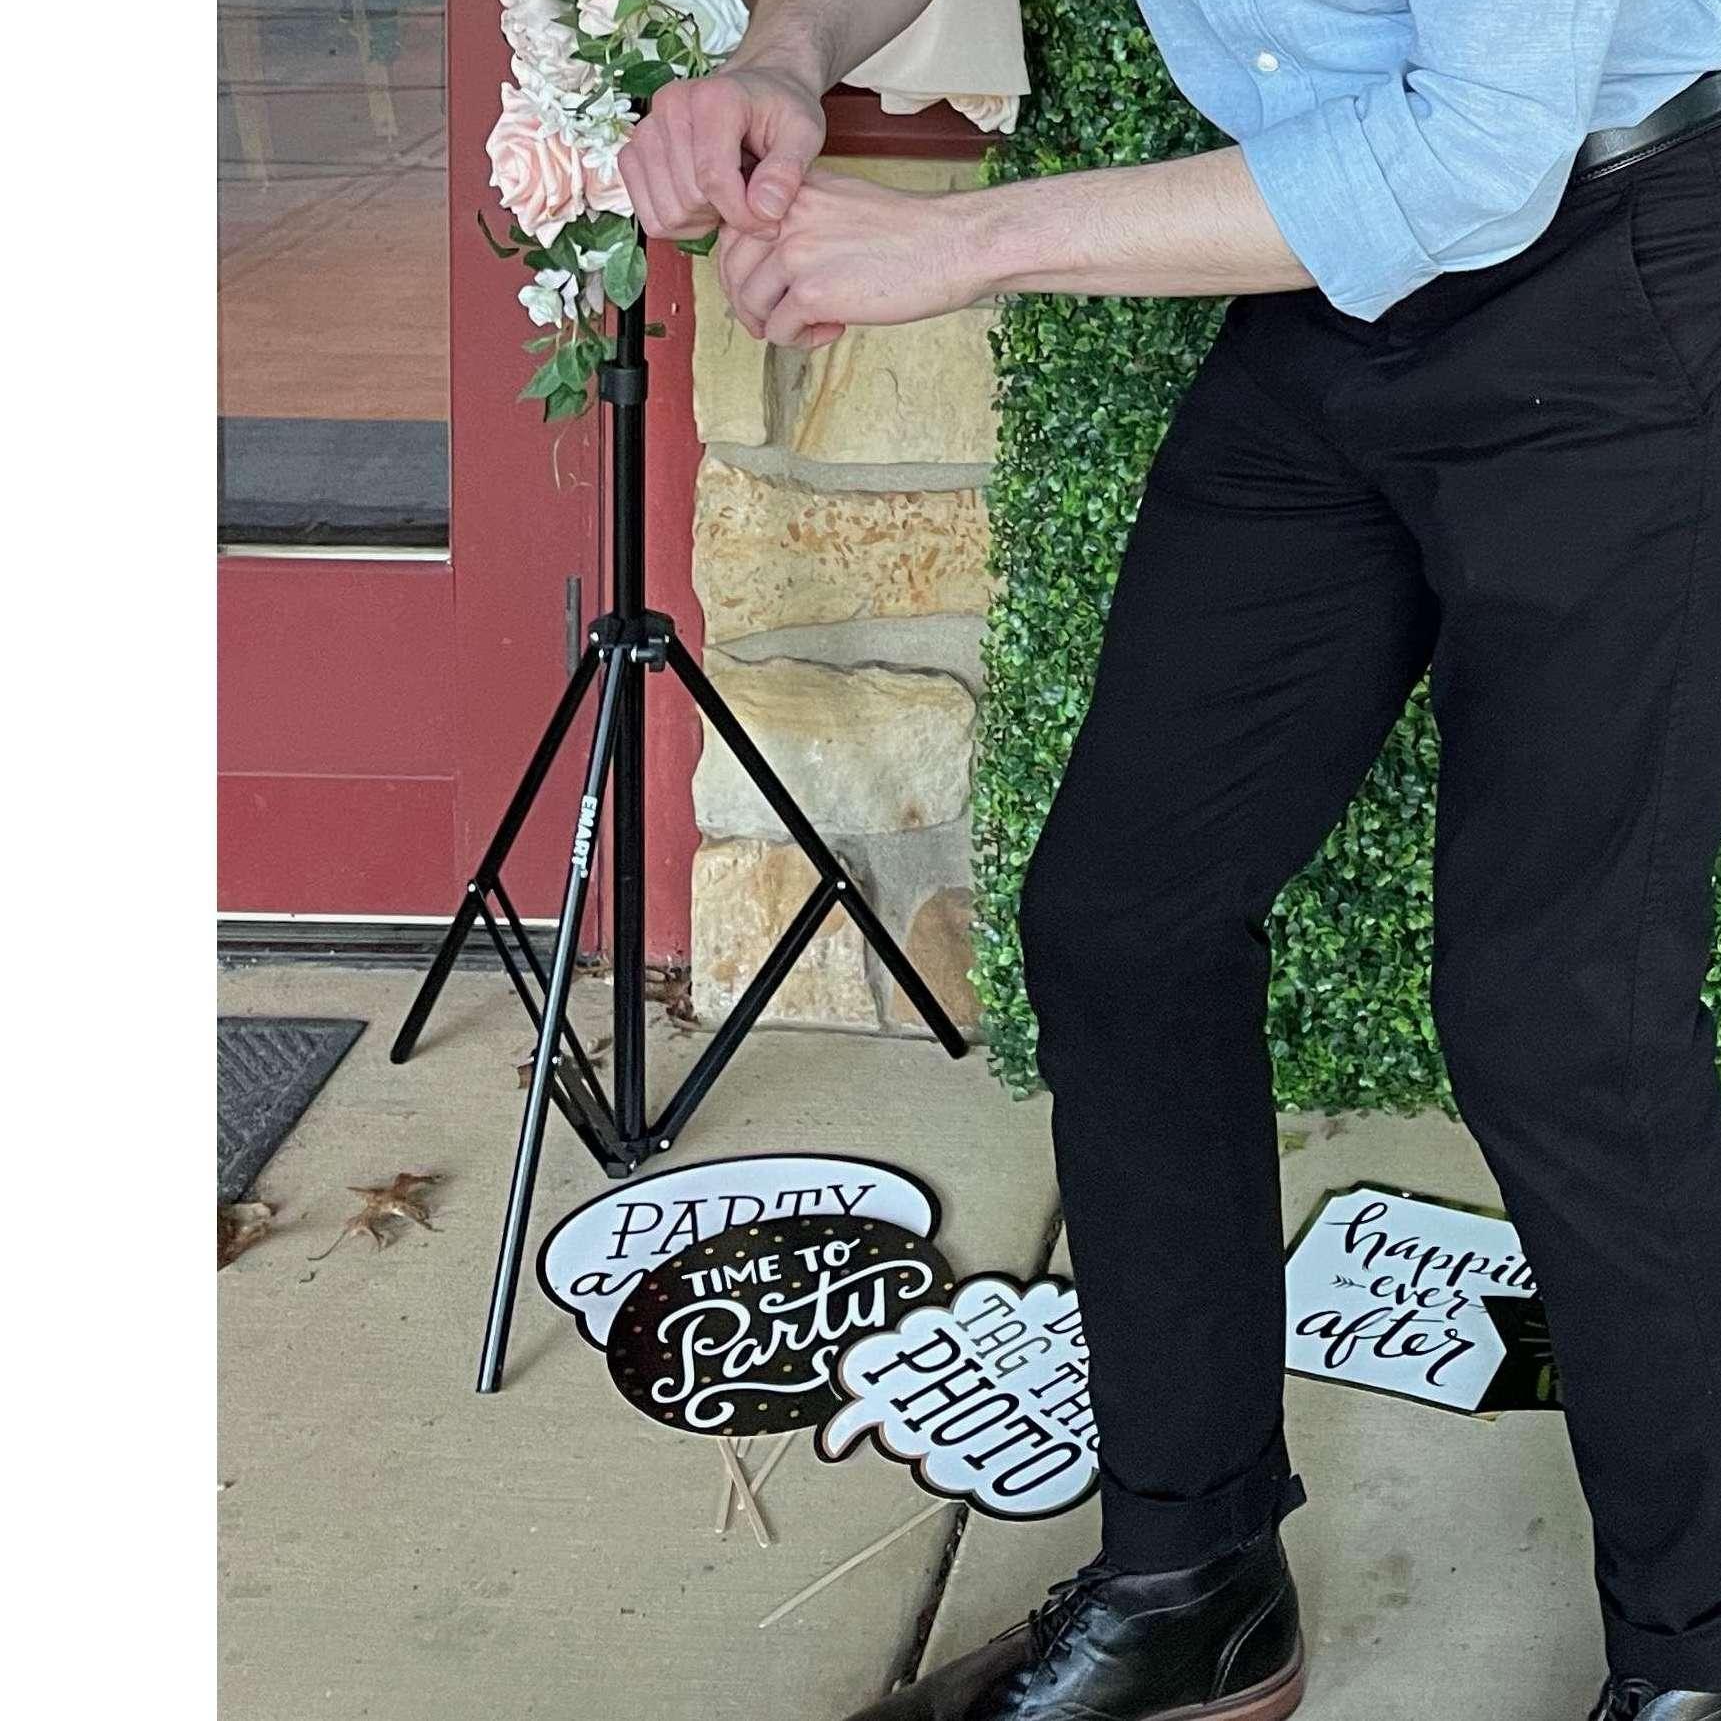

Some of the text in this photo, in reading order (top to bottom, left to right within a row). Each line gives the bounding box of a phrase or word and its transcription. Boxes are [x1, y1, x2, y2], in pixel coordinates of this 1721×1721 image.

[571, 794, 598, 871] EMART
[680, 1254, 782, 1298] TIME
[793, 1237, 861, 1273] TO
[1369, 1275, 1470, 1321] ever
[650, 1259, 933, 1429] Party
[955, 1293, 1053, 1379] TAG
[1295, 1306, 1476, 1387] after
[861, 1327, 1082, 1497] PHOTO
